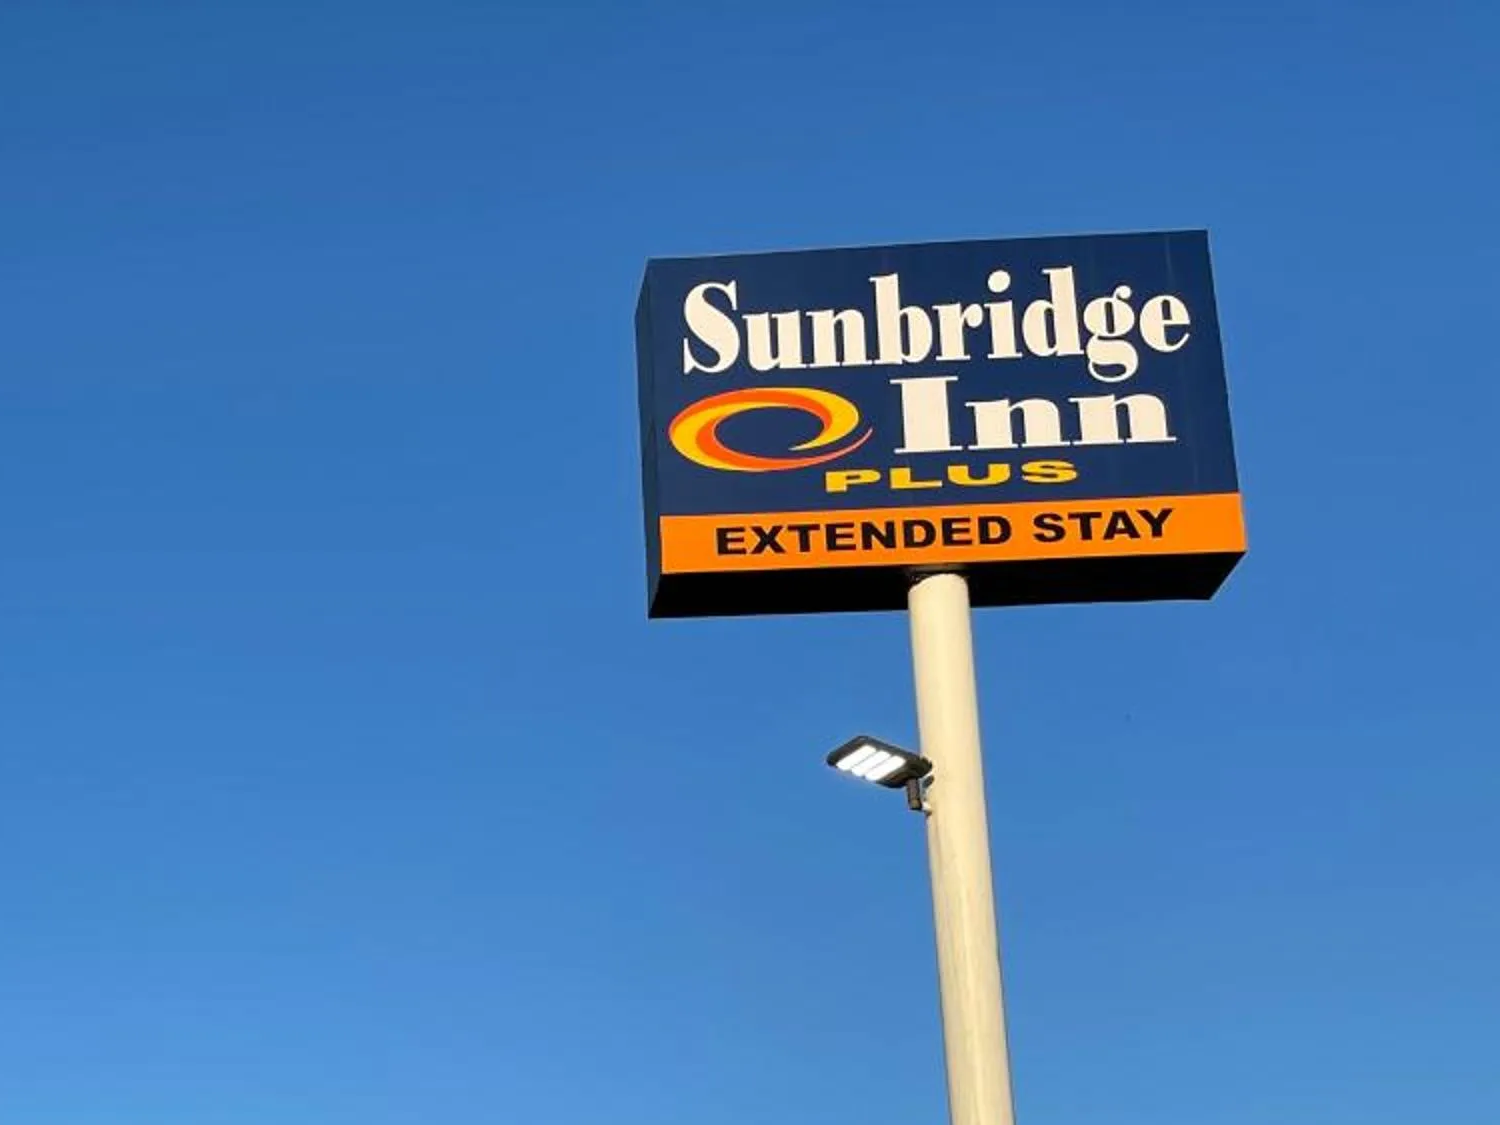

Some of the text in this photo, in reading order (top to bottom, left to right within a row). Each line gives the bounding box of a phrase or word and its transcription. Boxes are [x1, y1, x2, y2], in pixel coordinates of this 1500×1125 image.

[683, 266, 1191, 383] Sunbridge
[890, 376, 1177, 453] Inn
[825, 461, 1078, 494] PLUS
[715, 508, 1173, 556] EXTENDED STAY
